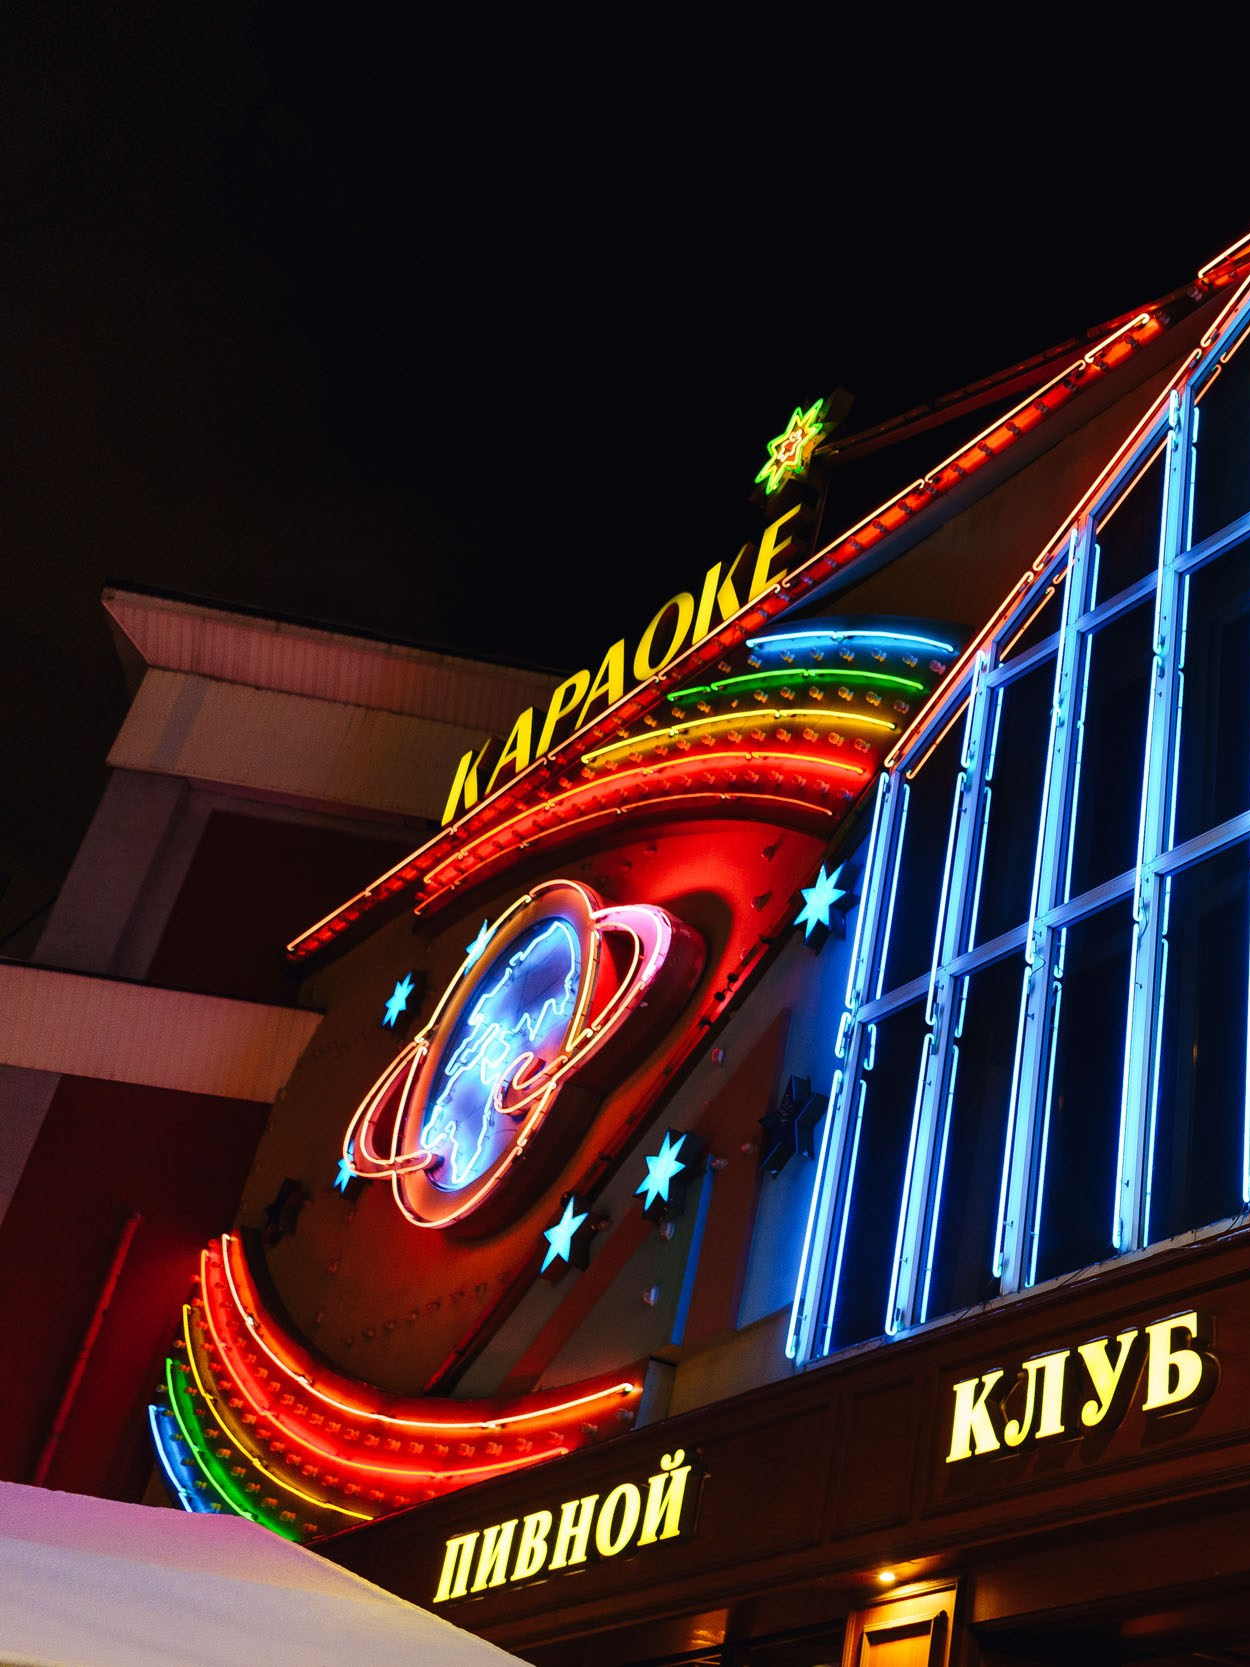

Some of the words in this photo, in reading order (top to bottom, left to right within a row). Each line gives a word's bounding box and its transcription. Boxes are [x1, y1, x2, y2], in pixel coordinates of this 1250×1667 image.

[441, 503, 801, 827] КАРАОКЕ
[945, 1310, 1204, 1464] КЛУБ
[433, 1448, 692, 1604] ПИВНОЙ
